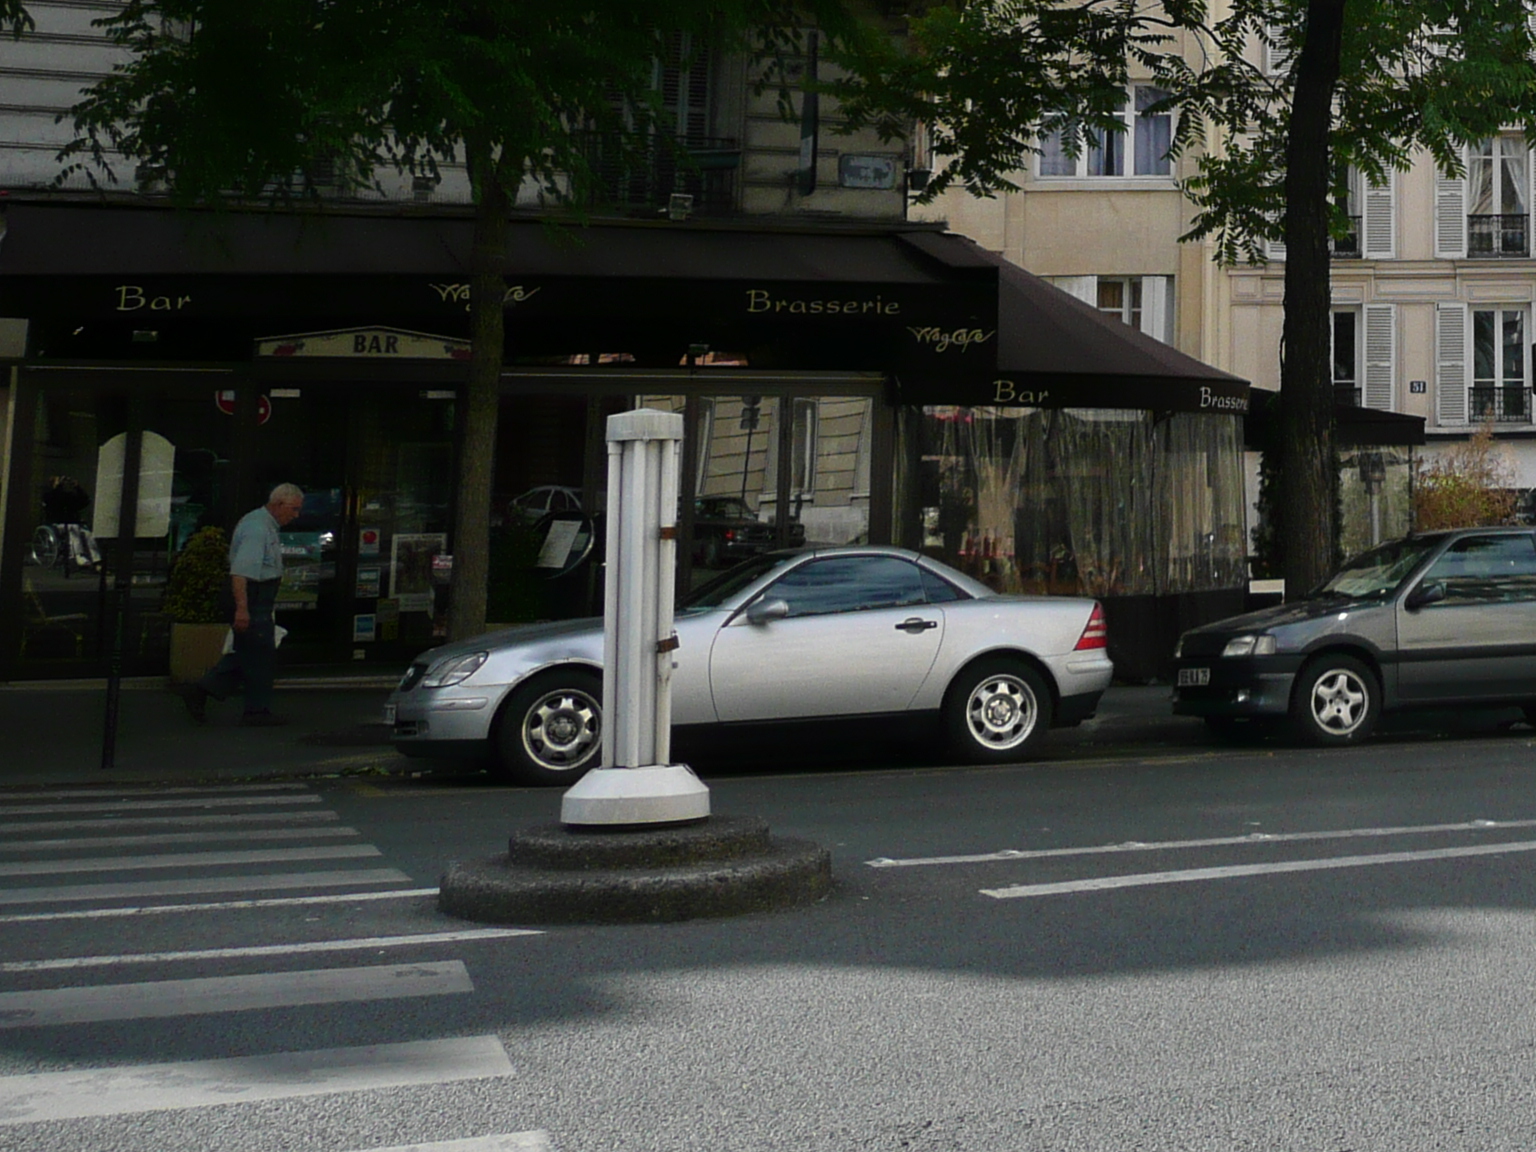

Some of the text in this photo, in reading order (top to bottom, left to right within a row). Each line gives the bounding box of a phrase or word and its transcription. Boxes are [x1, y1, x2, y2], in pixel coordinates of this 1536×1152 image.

[115, 285, 191, 311] Bar
[746, 289, 901, 314] Brasserie
[353, 335, 399, 353] BAR
[992, 380, 1050, 403] Bar
[1412, 382, 1424, 392] 51
